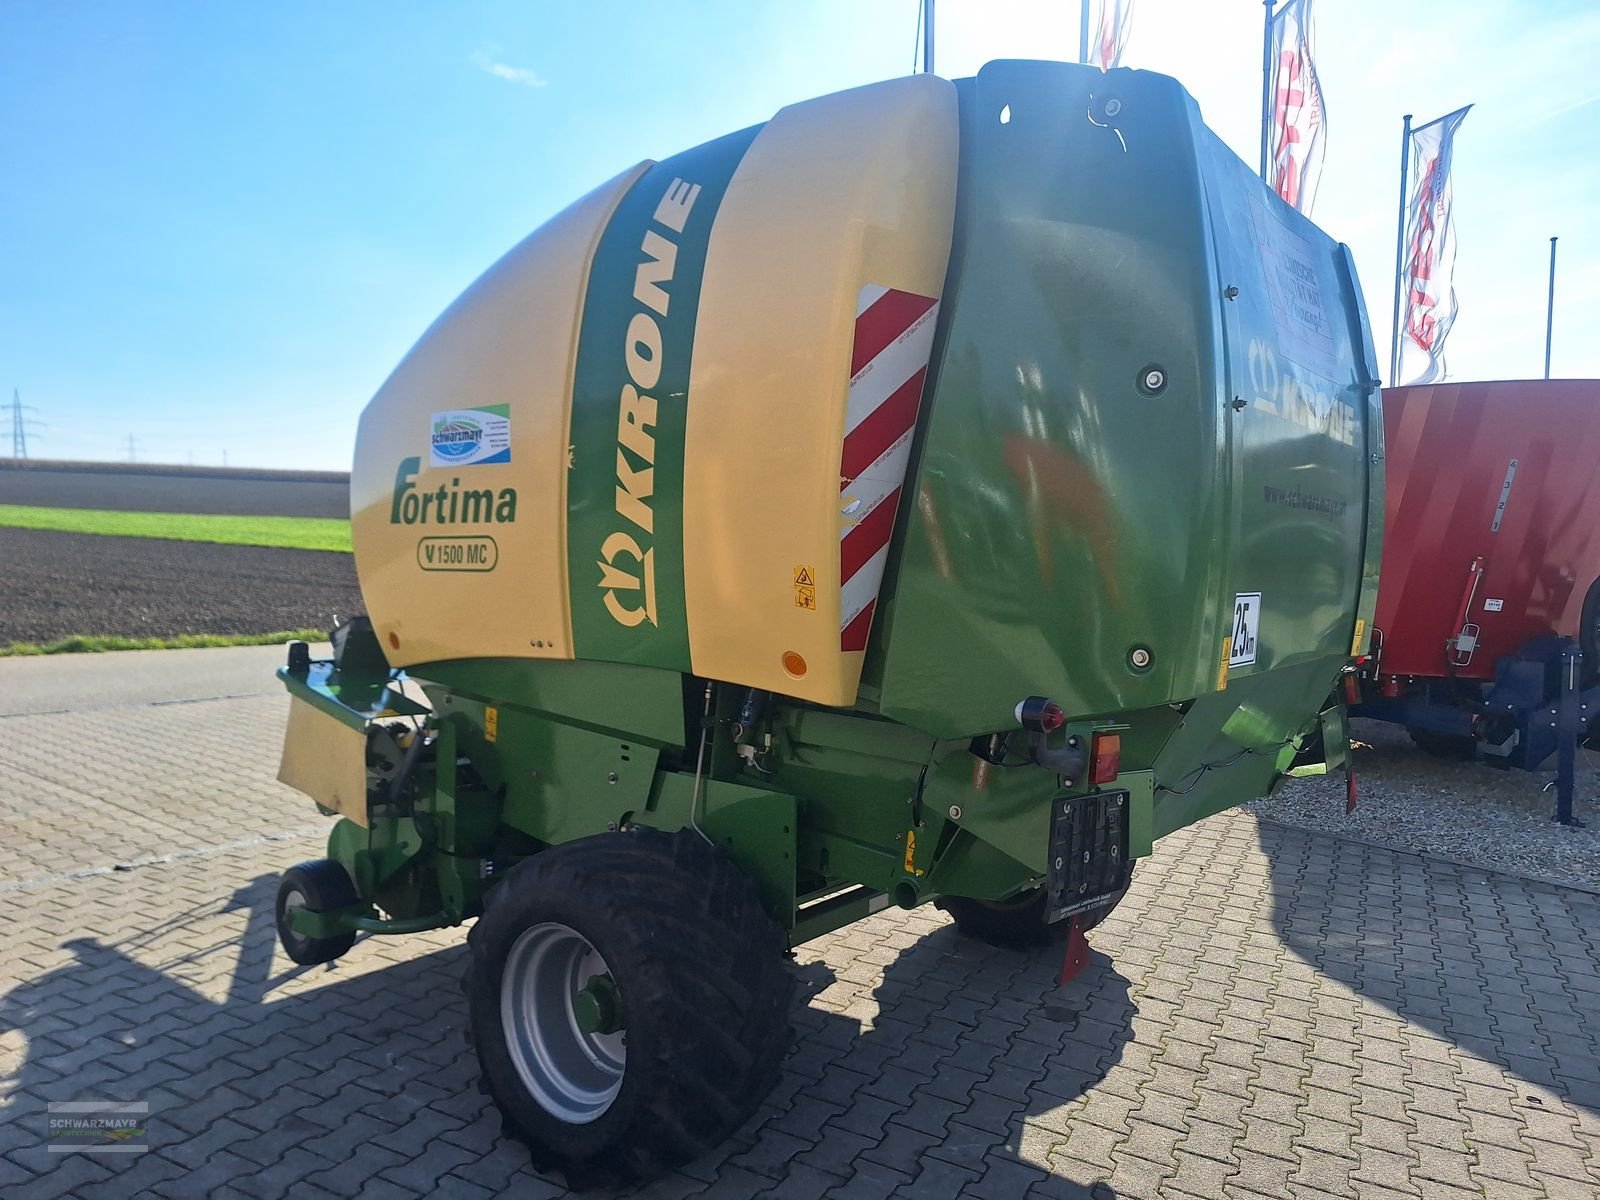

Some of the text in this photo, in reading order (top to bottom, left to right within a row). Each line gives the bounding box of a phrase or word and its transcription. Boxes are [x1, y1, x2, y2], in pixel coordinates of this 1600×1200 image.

[616, 176, 702, 536] KRONE
[431, 428, 483, 445] schwarzmayr
[390, 456, 518, 525] Fortima
[425, 544, 487, 563] V 1500 MC
[1231, 602, 1250, 658] 25
